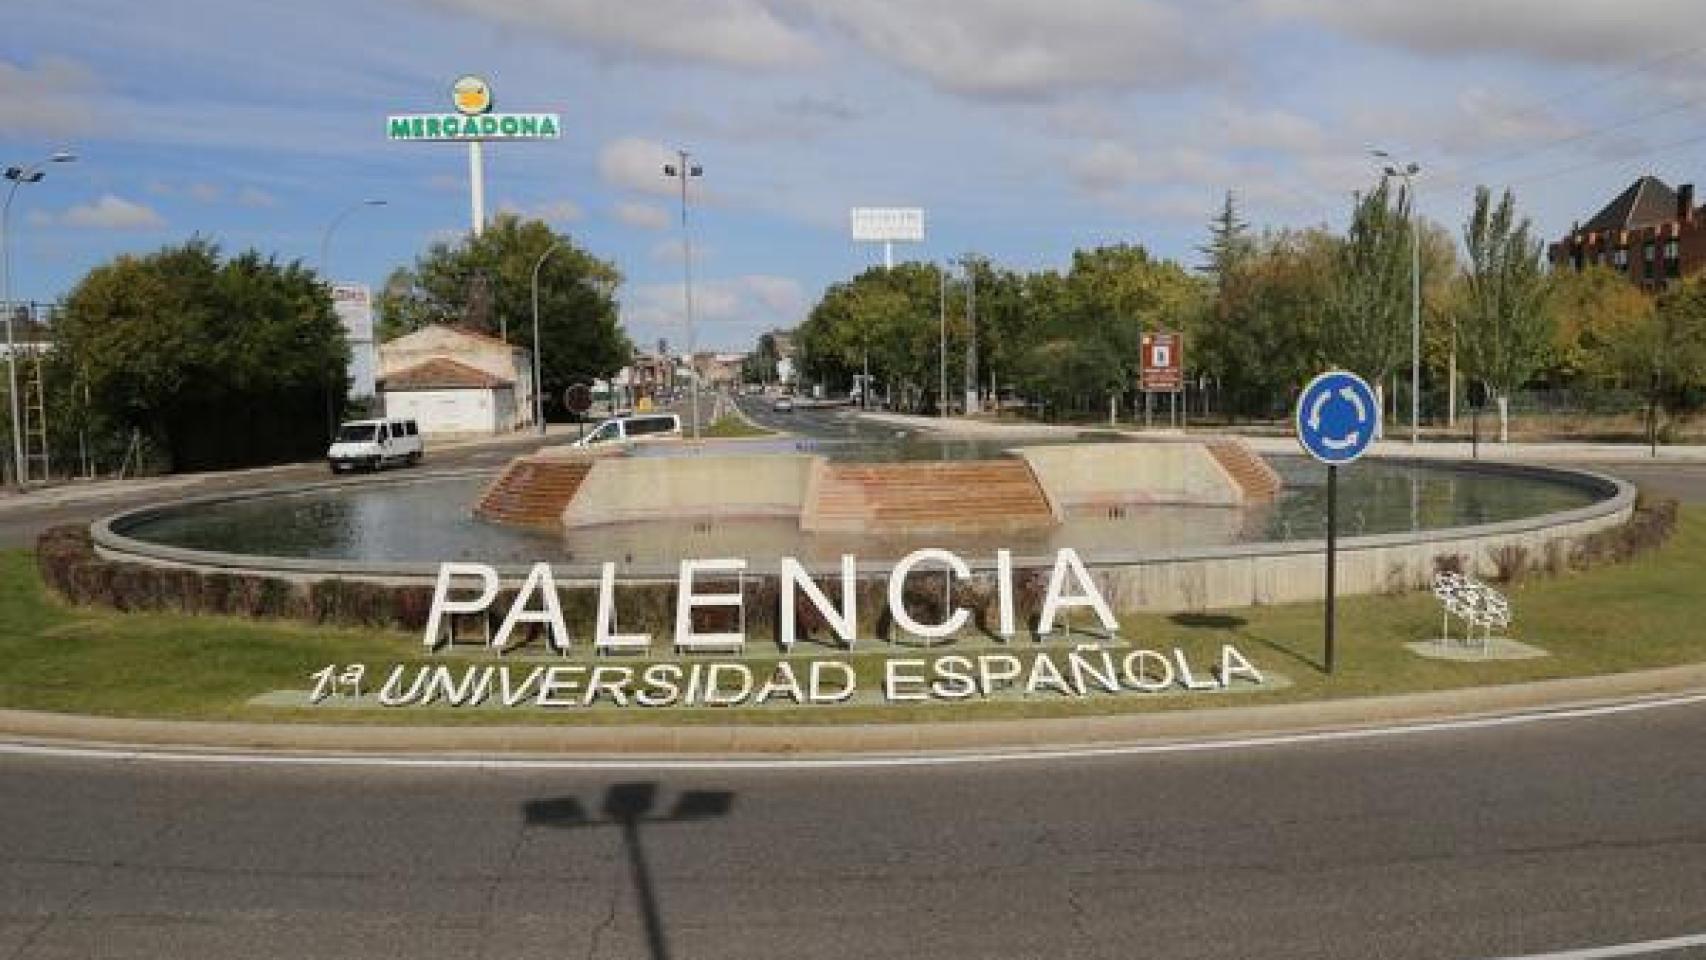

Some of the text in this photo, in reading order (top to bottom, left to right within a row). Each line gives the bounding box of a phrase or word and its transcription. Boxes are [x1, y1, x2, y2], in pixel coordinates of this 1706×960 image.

[391, 115, 556, 137] MERCADONA
[423, 547, 1120, 648] PALENCIA
[378, 660, 857, 708] UNIVERSIDAD
[885, 644, 1264, 701] ESPAÑOLA
